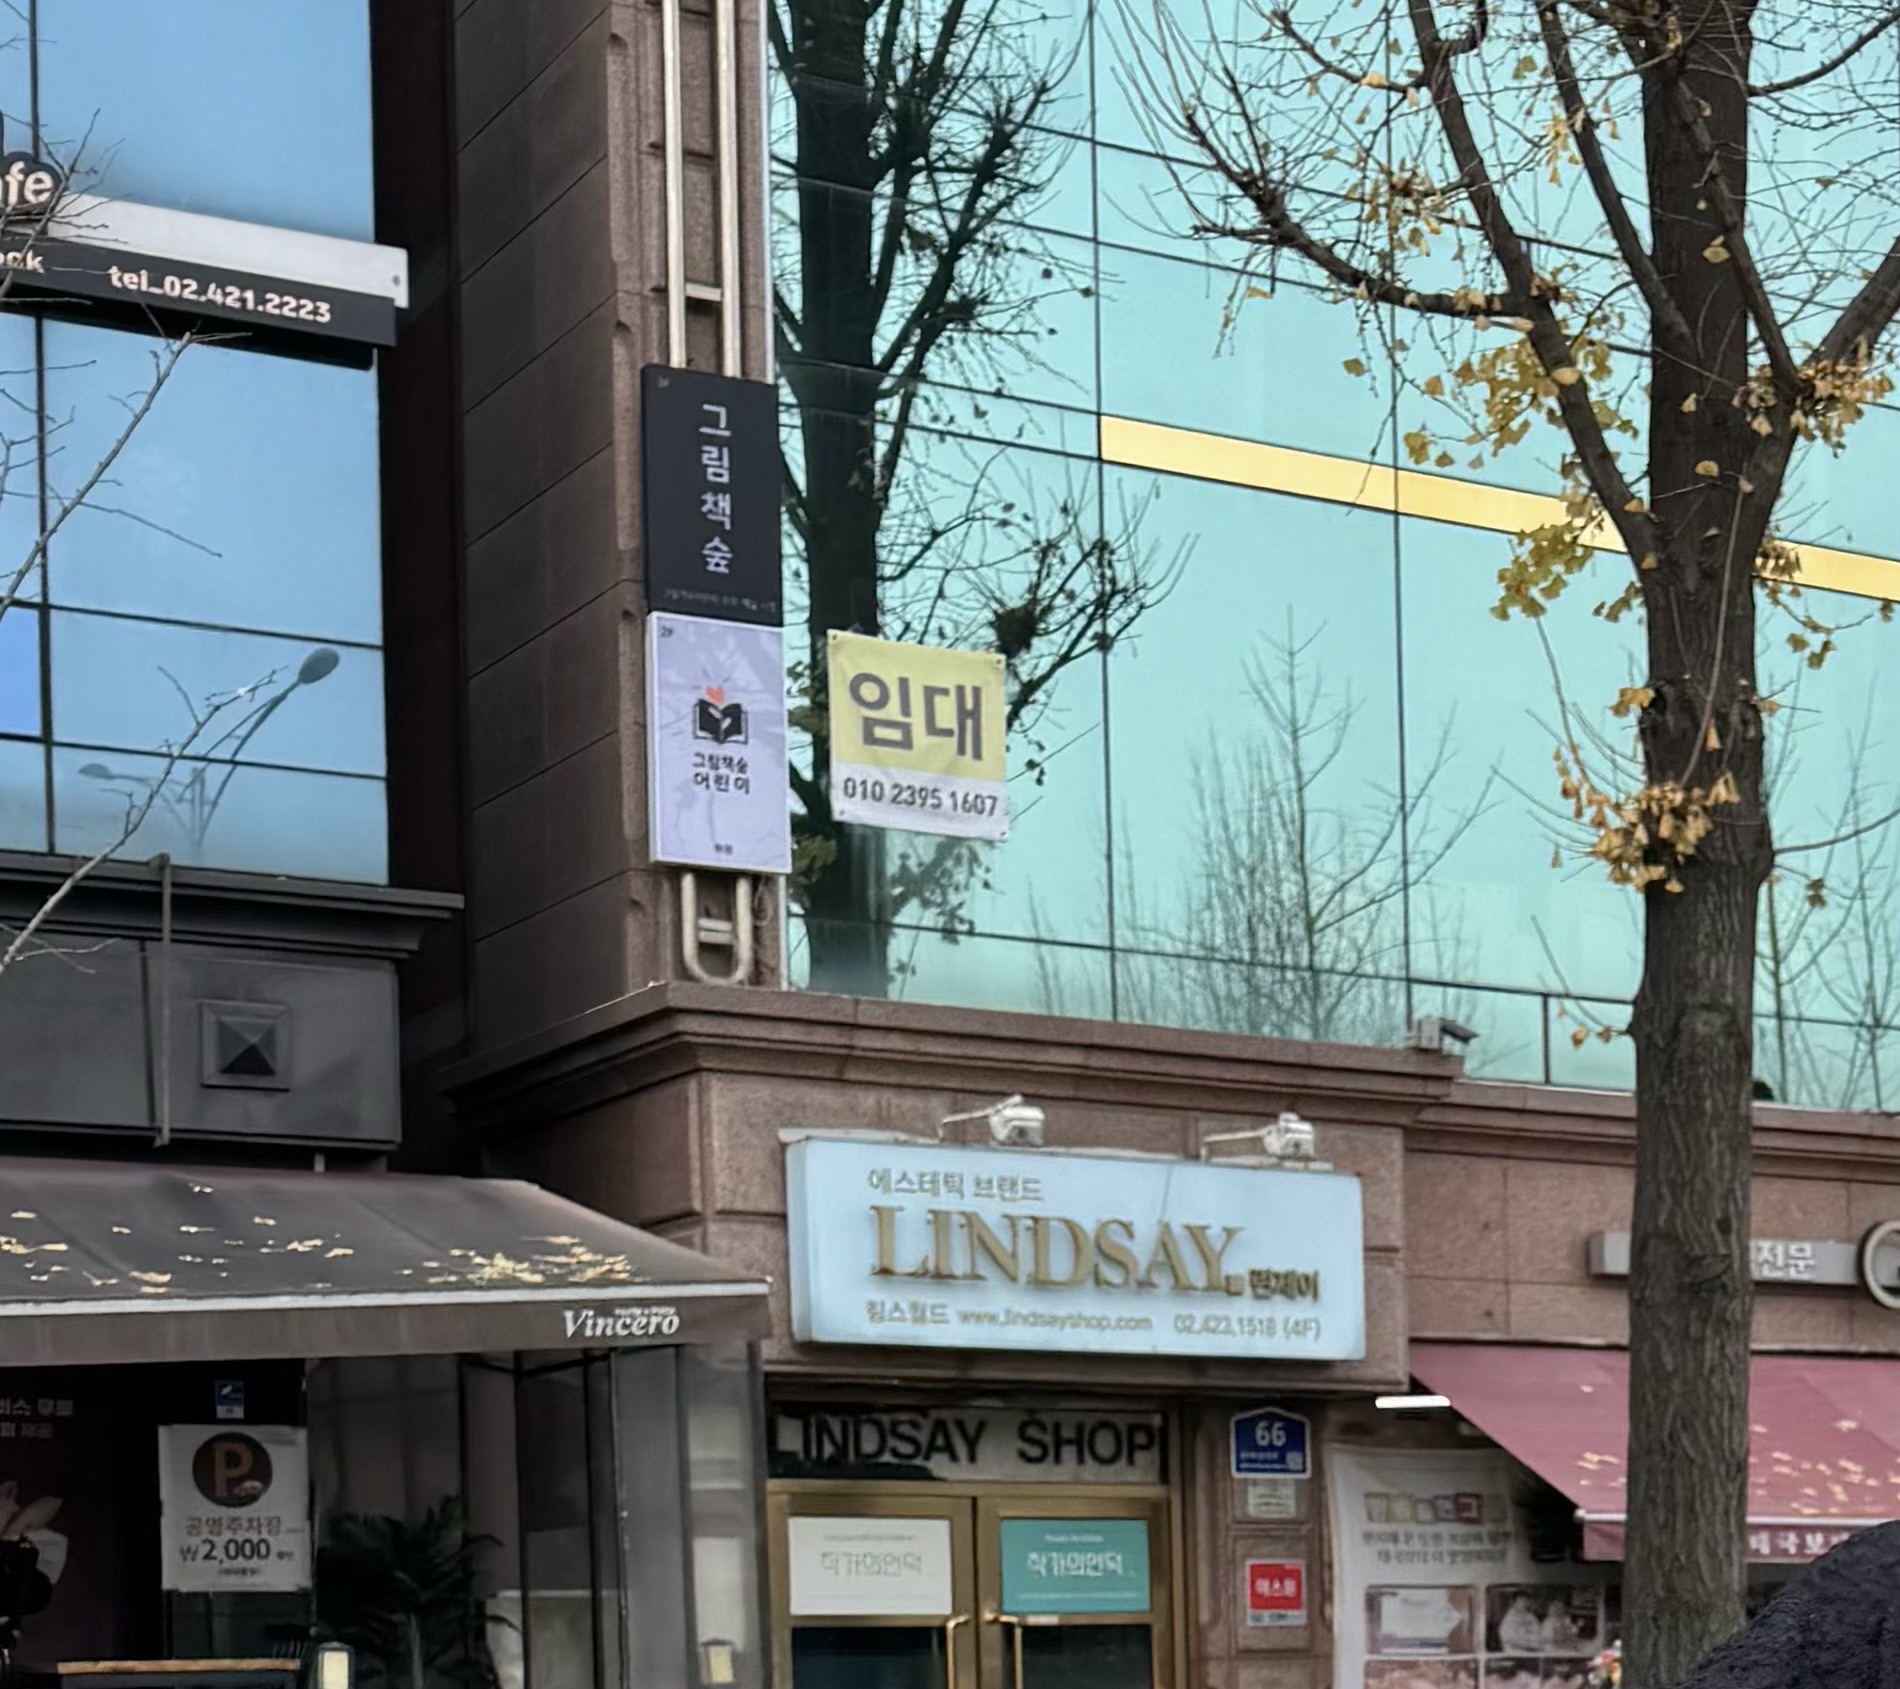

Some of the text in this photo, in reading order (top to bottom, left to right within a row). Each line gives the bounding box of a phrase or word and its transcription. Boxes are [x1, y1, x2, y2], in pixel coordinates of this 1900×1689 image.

[699, 403, 734, 574] 그림책숲
[849, 671, 984, 762] 임대
[693, 772, 751, 795] 어린이
[842, 776, 999, 817] 010 2395 1607
[867, 1167, 1045, 1201] 에스테틱 브랜드
[868, 1204, 1245, 1297] LINDSAY
[563, 1309, 680, 1339] Vincero
[1016, 1414, 1156, 1466] SHOP
[1254, 1420, 1287, 1447] 66
[210, 1441, 253, 1498] P
